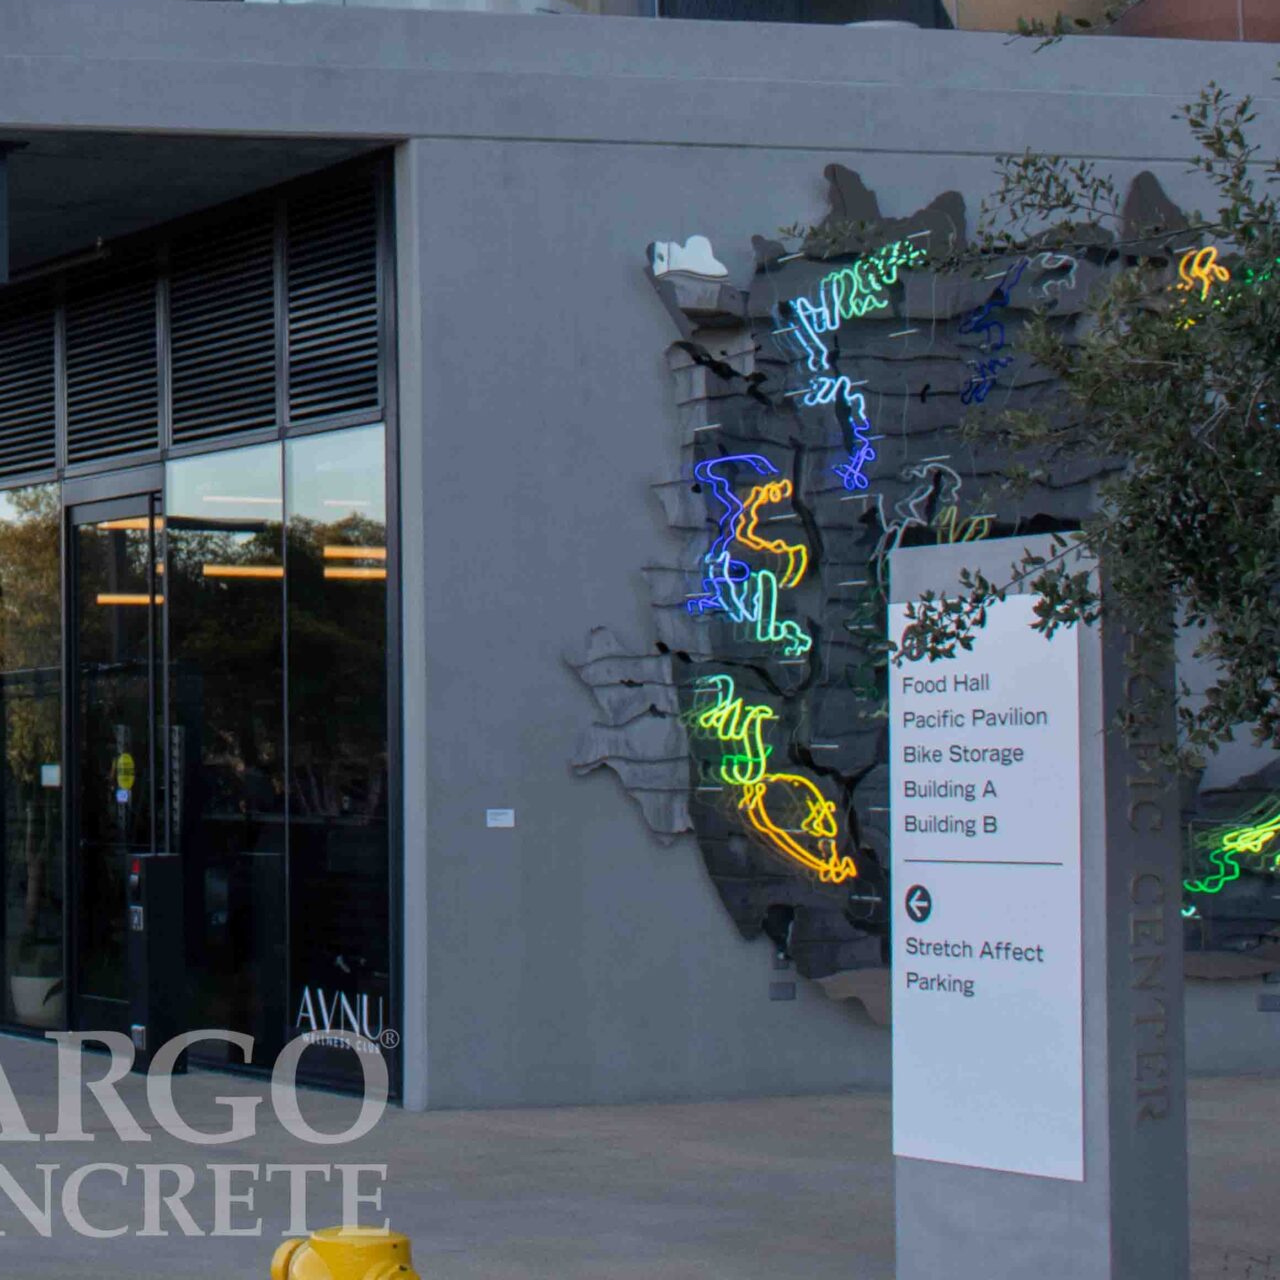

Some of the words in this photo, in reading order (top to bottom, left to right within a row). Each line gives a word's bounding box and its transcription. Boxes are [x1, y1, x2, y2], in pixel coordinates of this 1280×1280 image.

[902, 675, 947, 694] Food
[954, 673, 990, 692] Hall
[903, 709, 965, 728] Pacific
[972, 707, 1048, 726] Pavilion
[903, 745, 943, 763] Bike
[949, 744, 1024, 766] Storage
[904, 780, 976, 801] Building
[982, 780, 998, 798] A
[904, 815, 976, 837] Building
[983, 815, 998, 833] B
[905, 937, 973, 958] Stretch
[980, 941, 1044, 962] Affect
[906, 972, 975, 998] Parking
[1129, 871, 1171, 1125] CENTER
[296, 985, 383, 1040] AVNU
